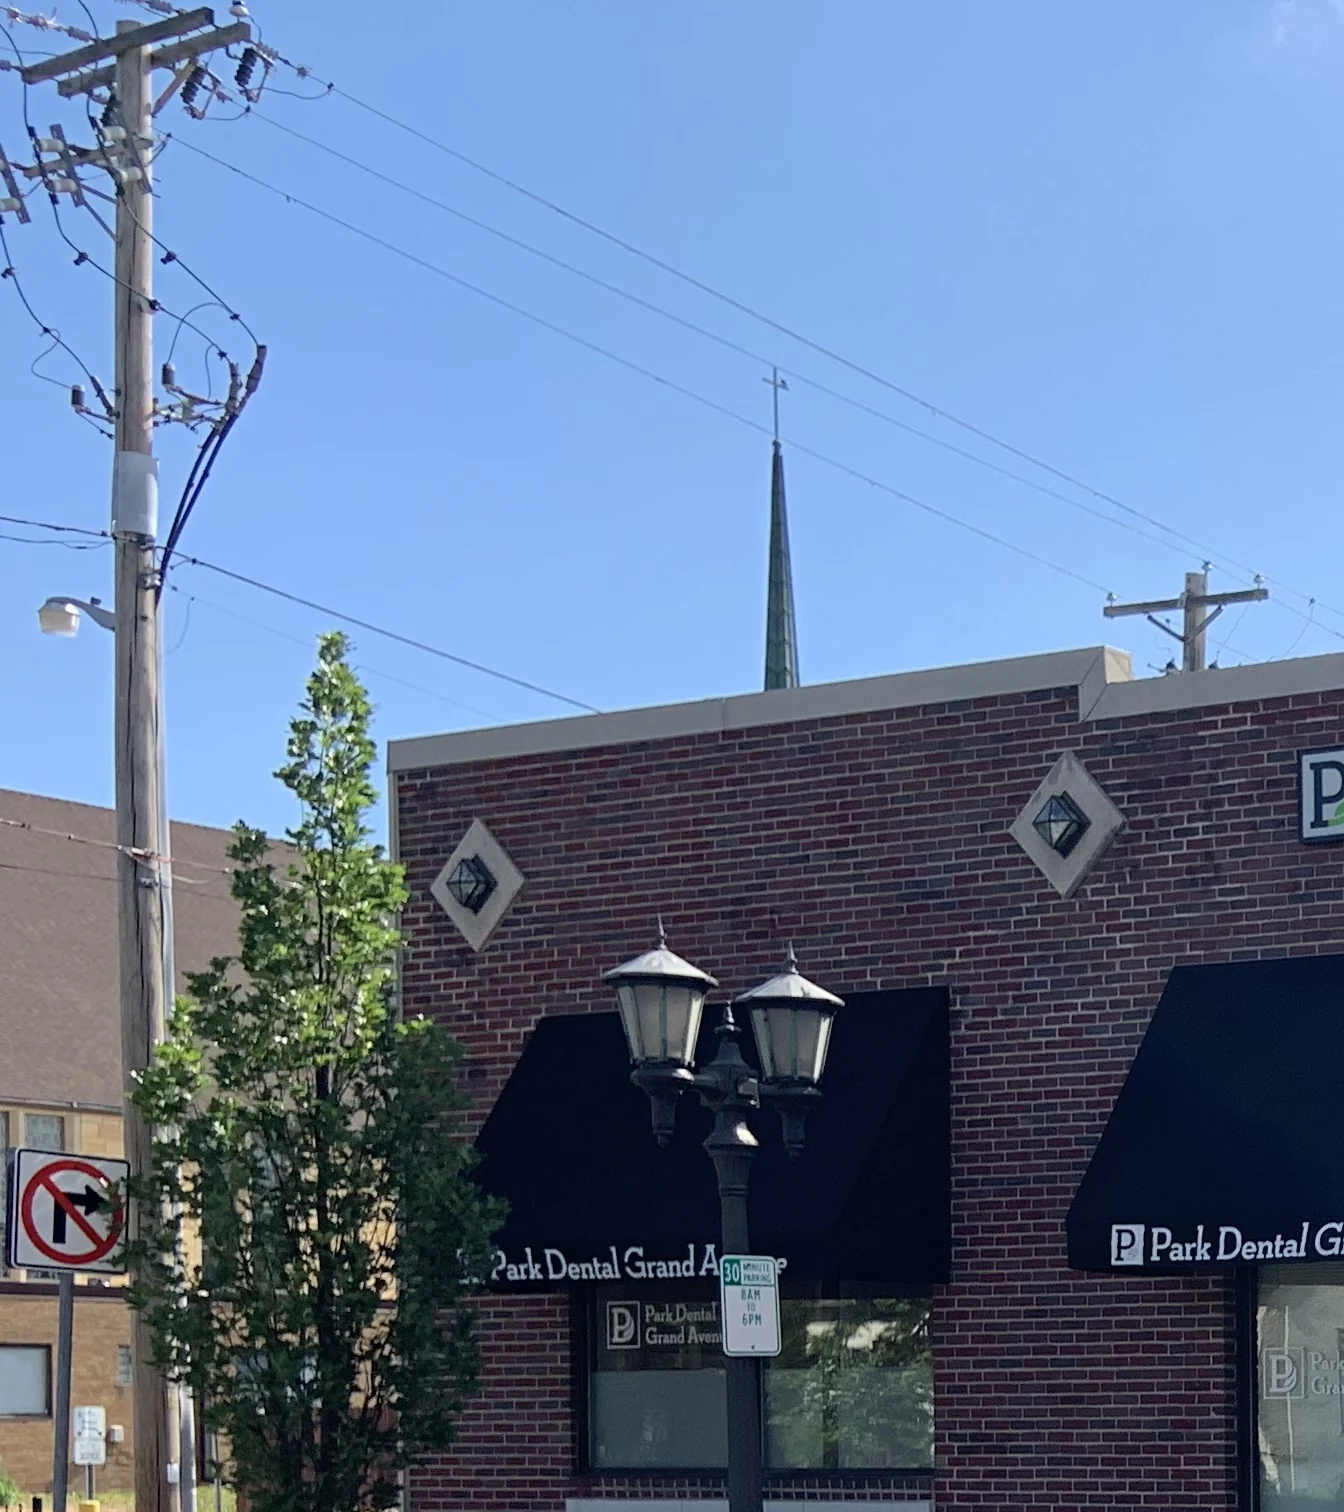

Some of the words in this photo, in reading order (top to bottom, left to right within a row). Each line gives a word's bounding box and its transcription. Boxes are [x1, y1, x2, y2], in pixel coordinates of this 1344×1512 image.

[1150, 1224, 1211, 1262] Park
[1216, 1222, 1308, 1261] Dental
[491, 1247, 544, 1281] Park
[543, 1245, 621, 1281] Dental
[624, 1243, 696, 1280] Grand
[724, 1262, 740, 1283] 30
[741, 1288, 761, 1301] 8AM
[645, 1304, 673, 1323] Park
[675, 1301, 717, 1323] Dental
[742, 1313, 762, 1326] 6PM
[645, 1326, 685, 1345] Grand
[1309, 1351, 1344, 1371] Park
